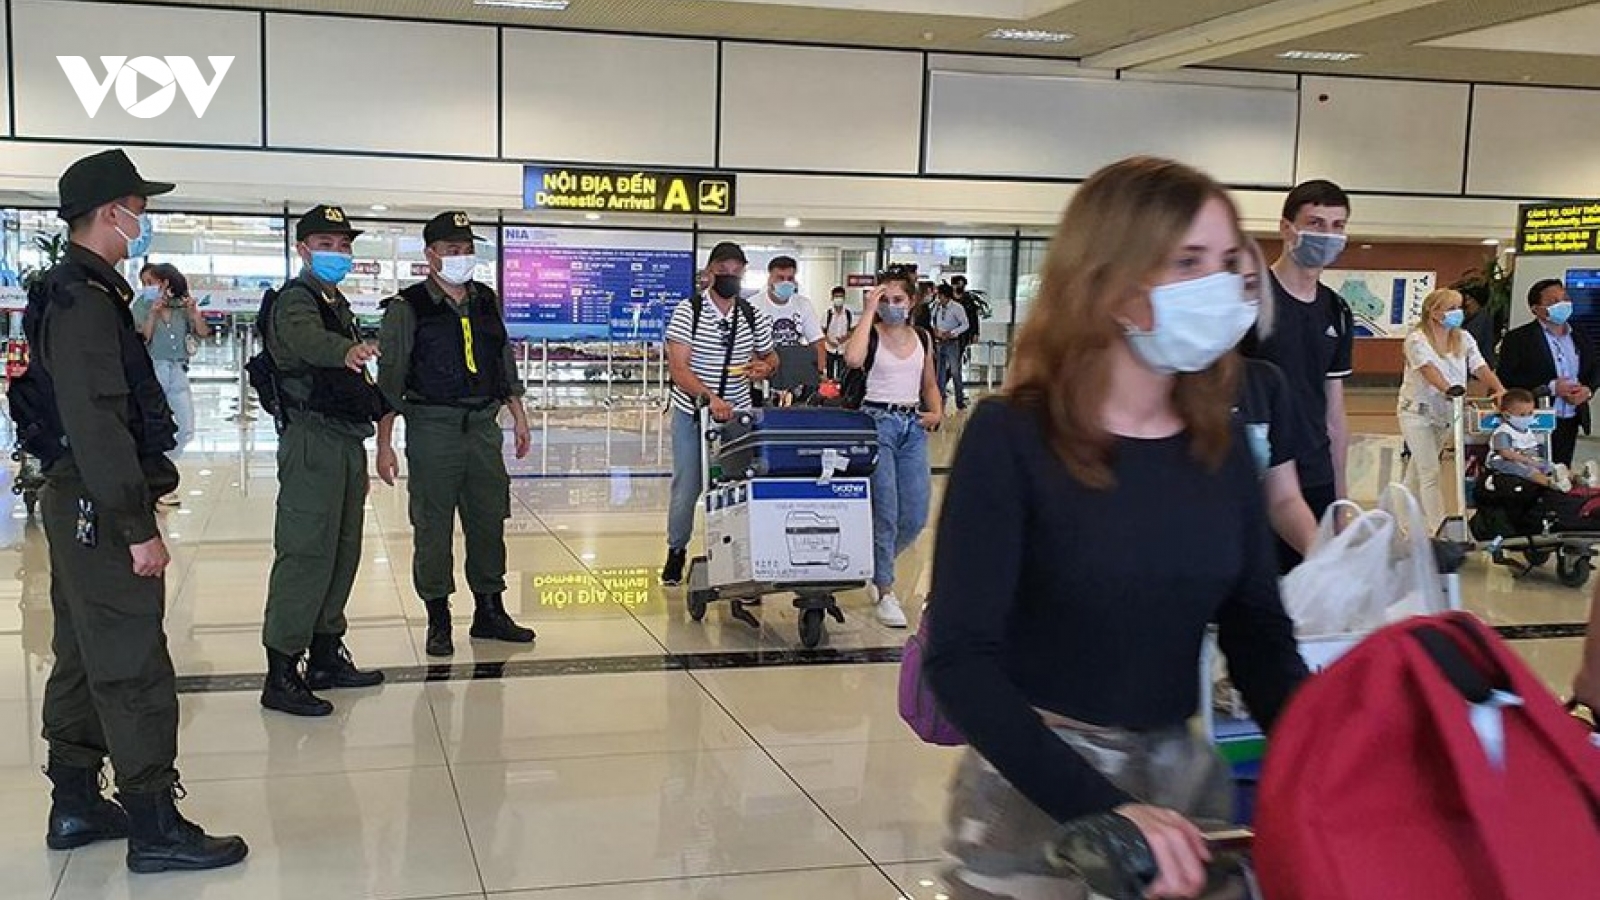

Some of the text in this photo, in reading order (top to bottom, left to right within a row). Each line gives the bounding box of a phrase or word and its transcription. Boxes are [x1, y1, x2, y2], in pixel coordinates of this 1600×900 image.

[543, 171, 656, 194] NỘI ĐỊA ĐẾN
[535, 192, 656, 210] Domestic Arrival
[663, 179, 691, 211] A
[505, 229, 529, 240] NIA
[832, 484, 864, 494] brother
